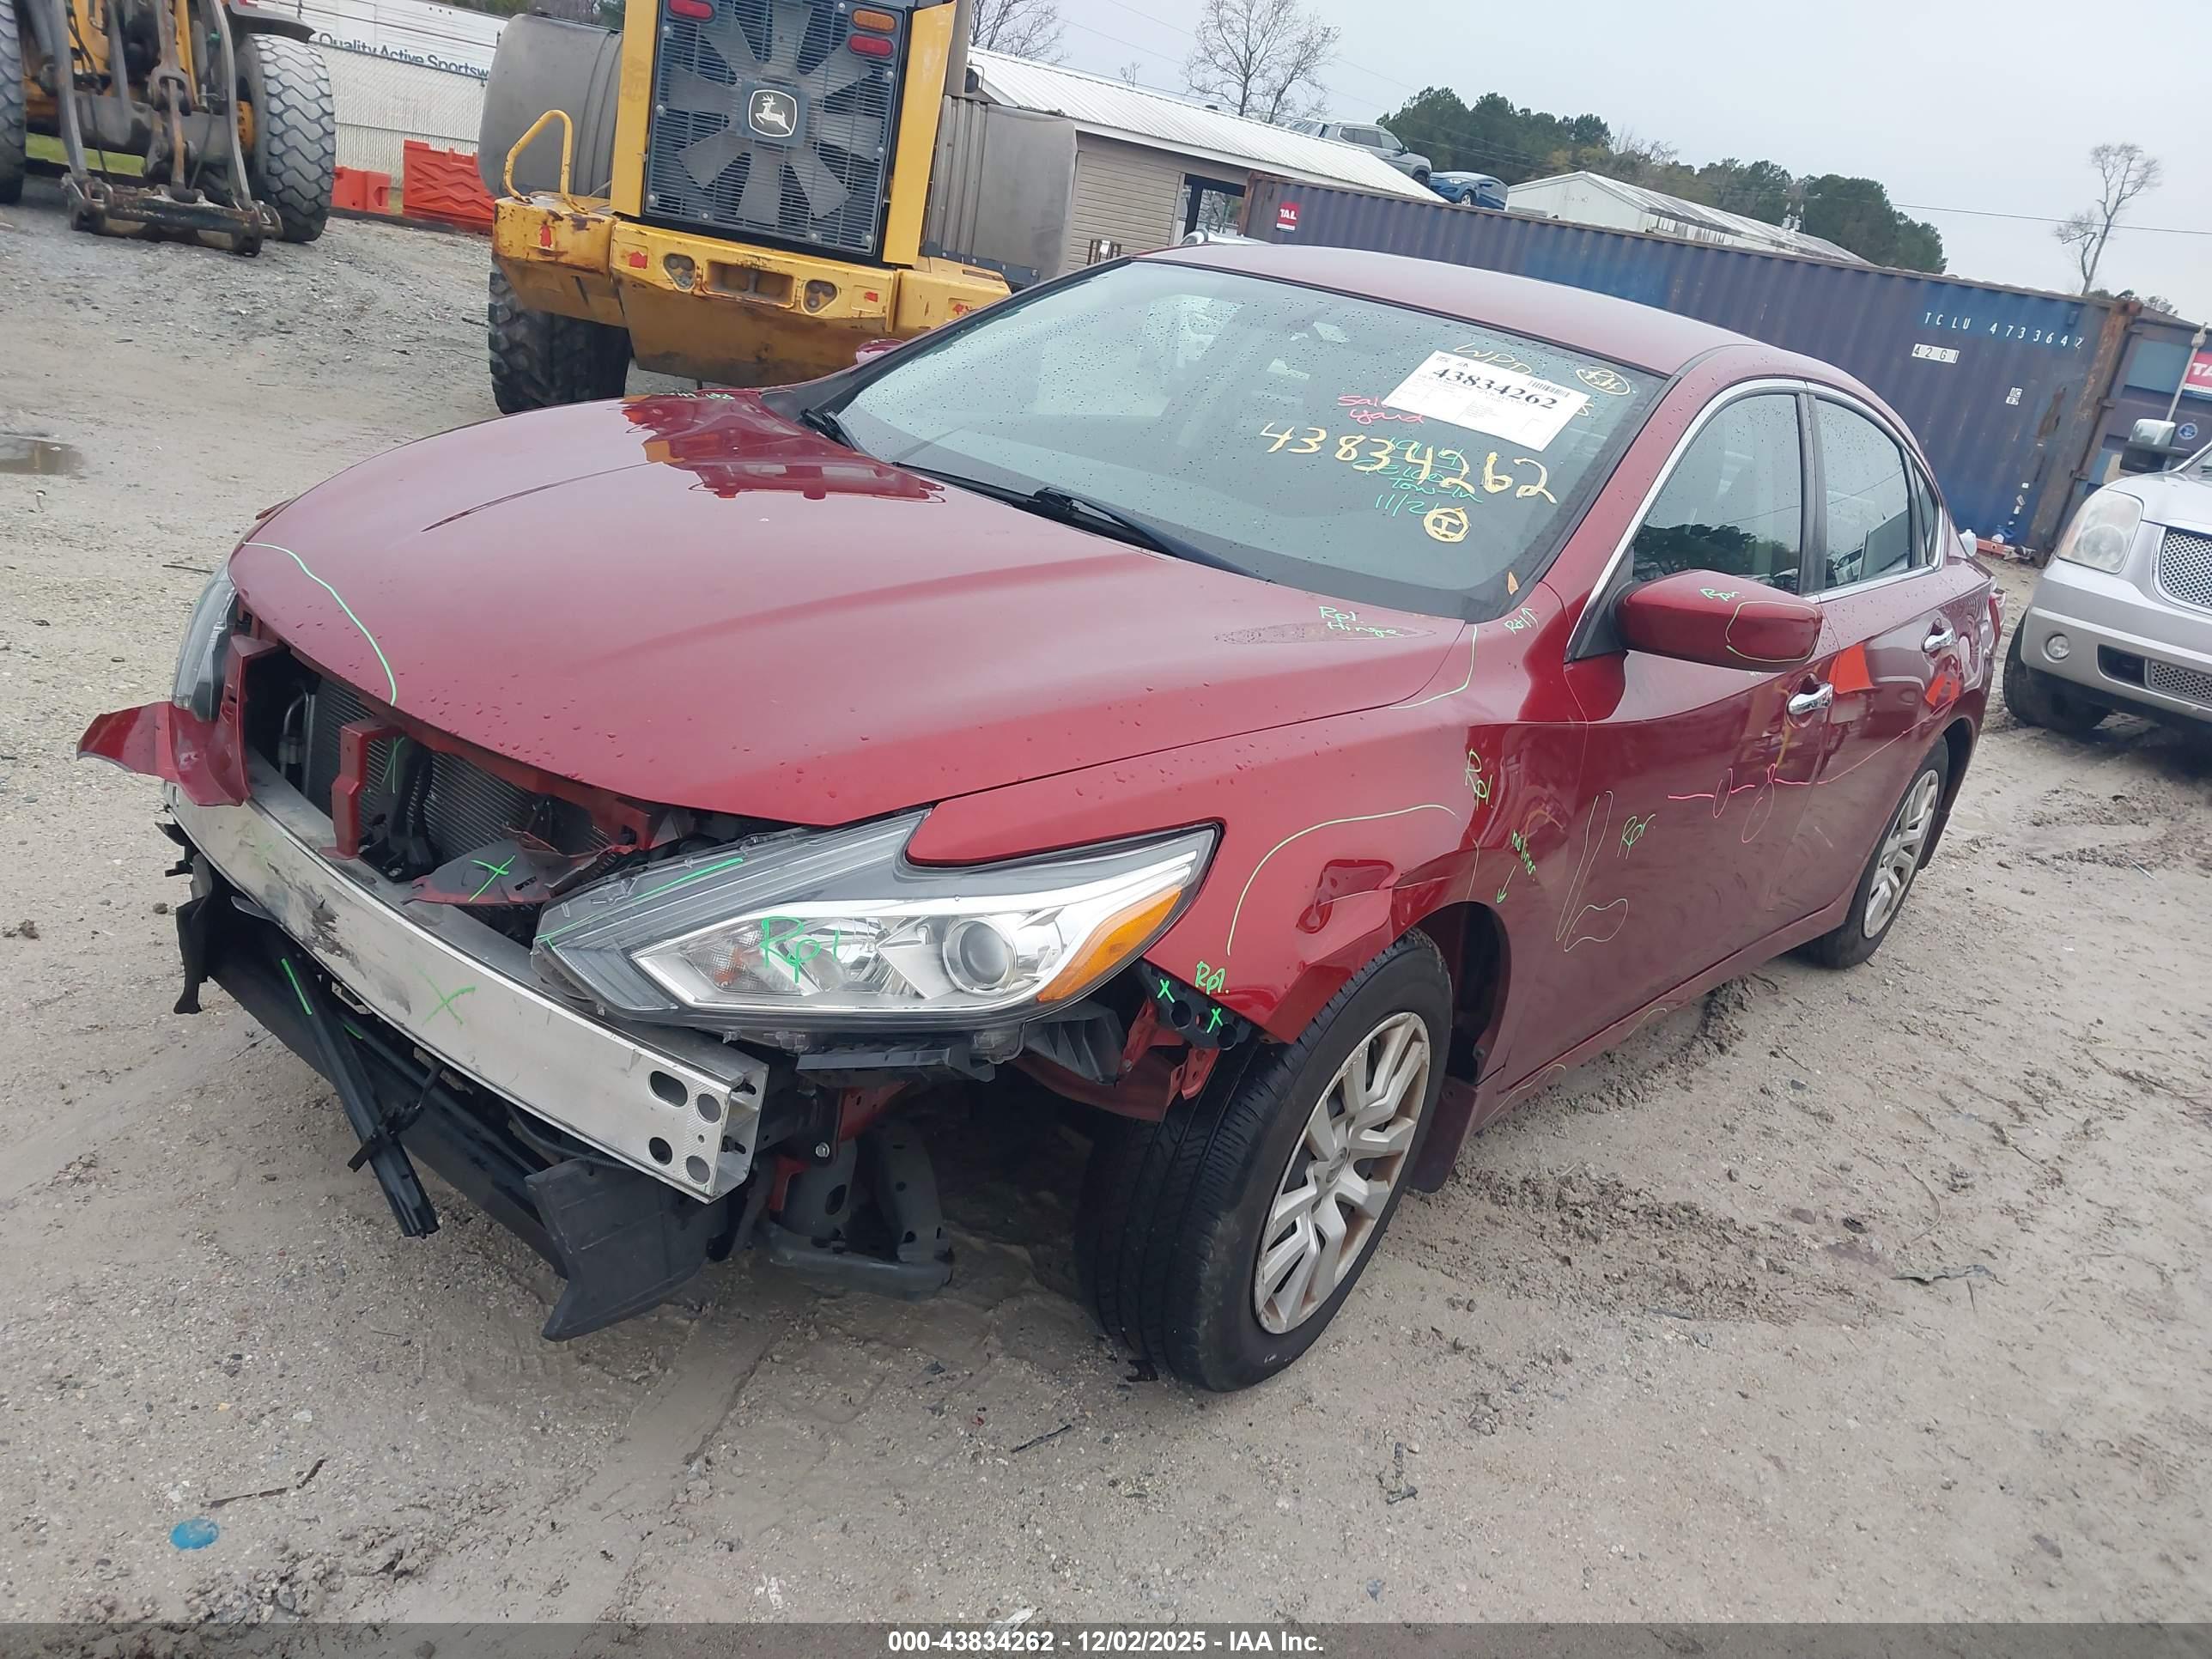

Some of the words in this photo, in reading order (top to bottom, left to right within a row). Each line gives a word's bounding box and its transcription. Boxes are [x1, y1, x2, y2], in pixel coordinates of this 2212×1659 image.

[319, 33, 378, 55] Quality
[380, 45, 424, 64] Active
[1279, 209, 1297, 221] TAL
[1924, 312, 1972, 331] TCLU
[1432, 368, 1558, 410] 43834262
[1259, 422, 1558, 505] 43834262
